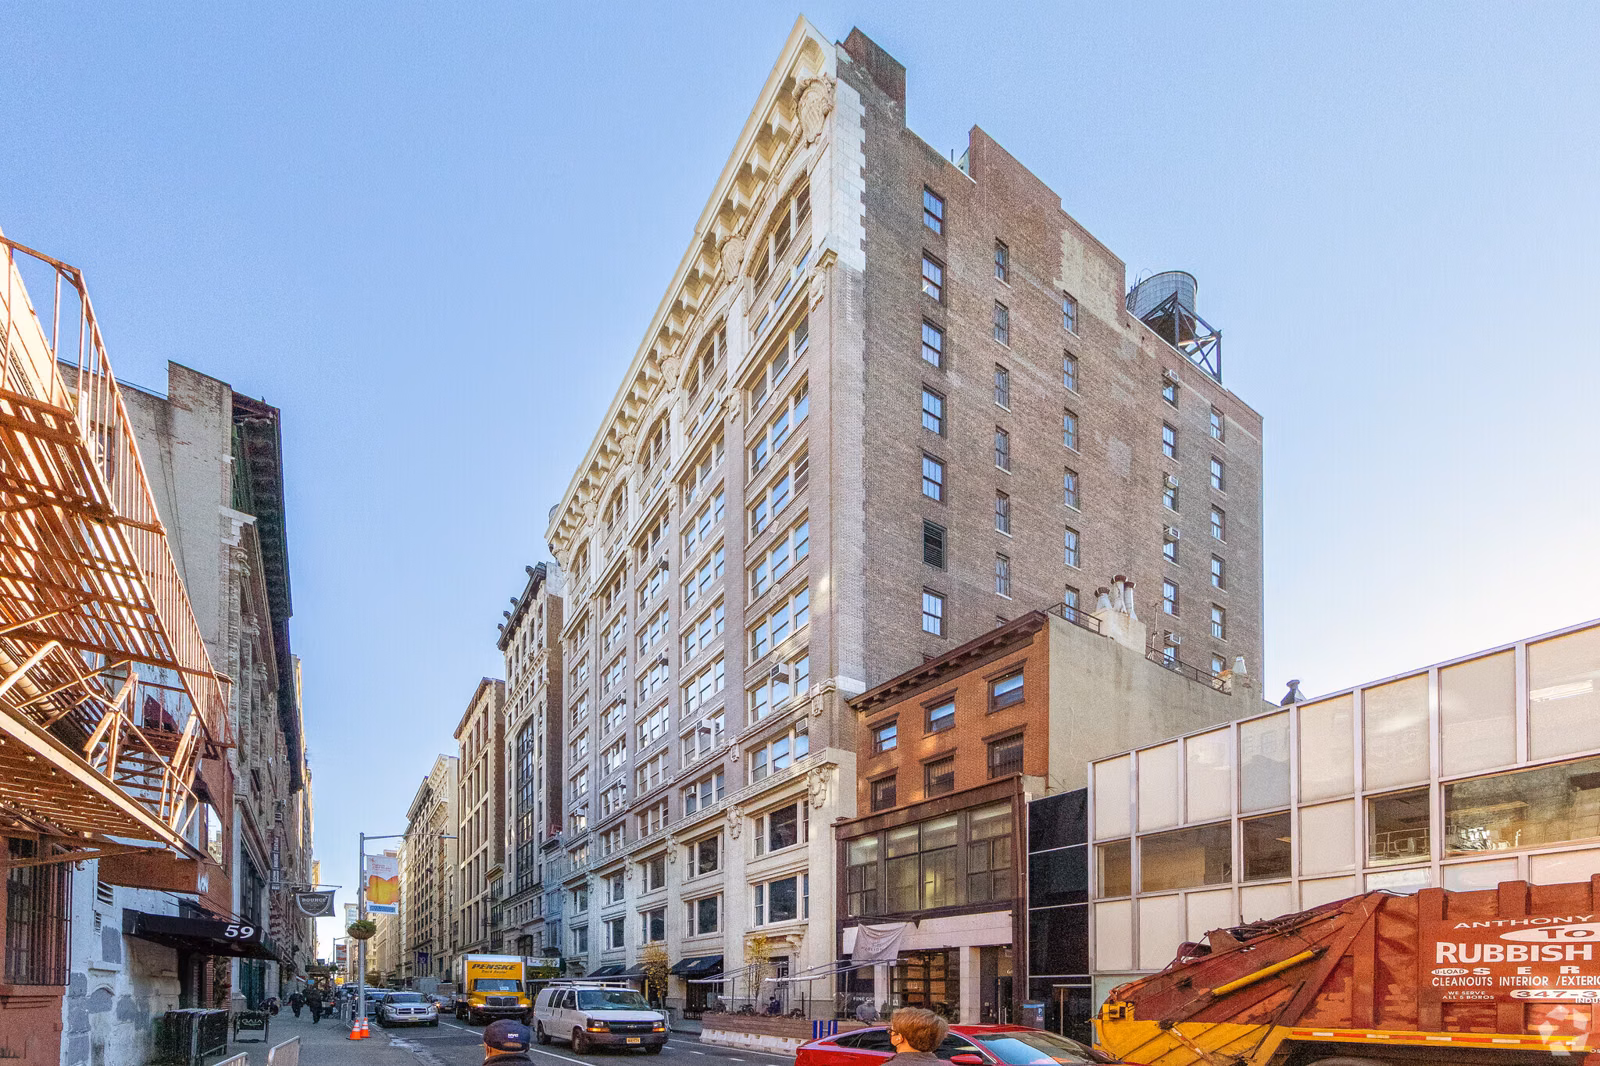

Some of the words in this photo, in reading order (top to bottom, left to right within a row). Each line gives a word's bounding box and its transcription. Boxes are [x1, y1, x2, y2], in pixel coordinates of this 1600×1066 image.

[1454, 915, 1594, 929] ANTHONY
[224, 924, 254, 939] 59
[1435, 941, 1593, 965] RUBBISH
[471, 963, 517, 971] PENSKE
[1432, 976, 1493, 986] CLEANOUTS
[1499, 976, 1549, 987] INTERIOR
